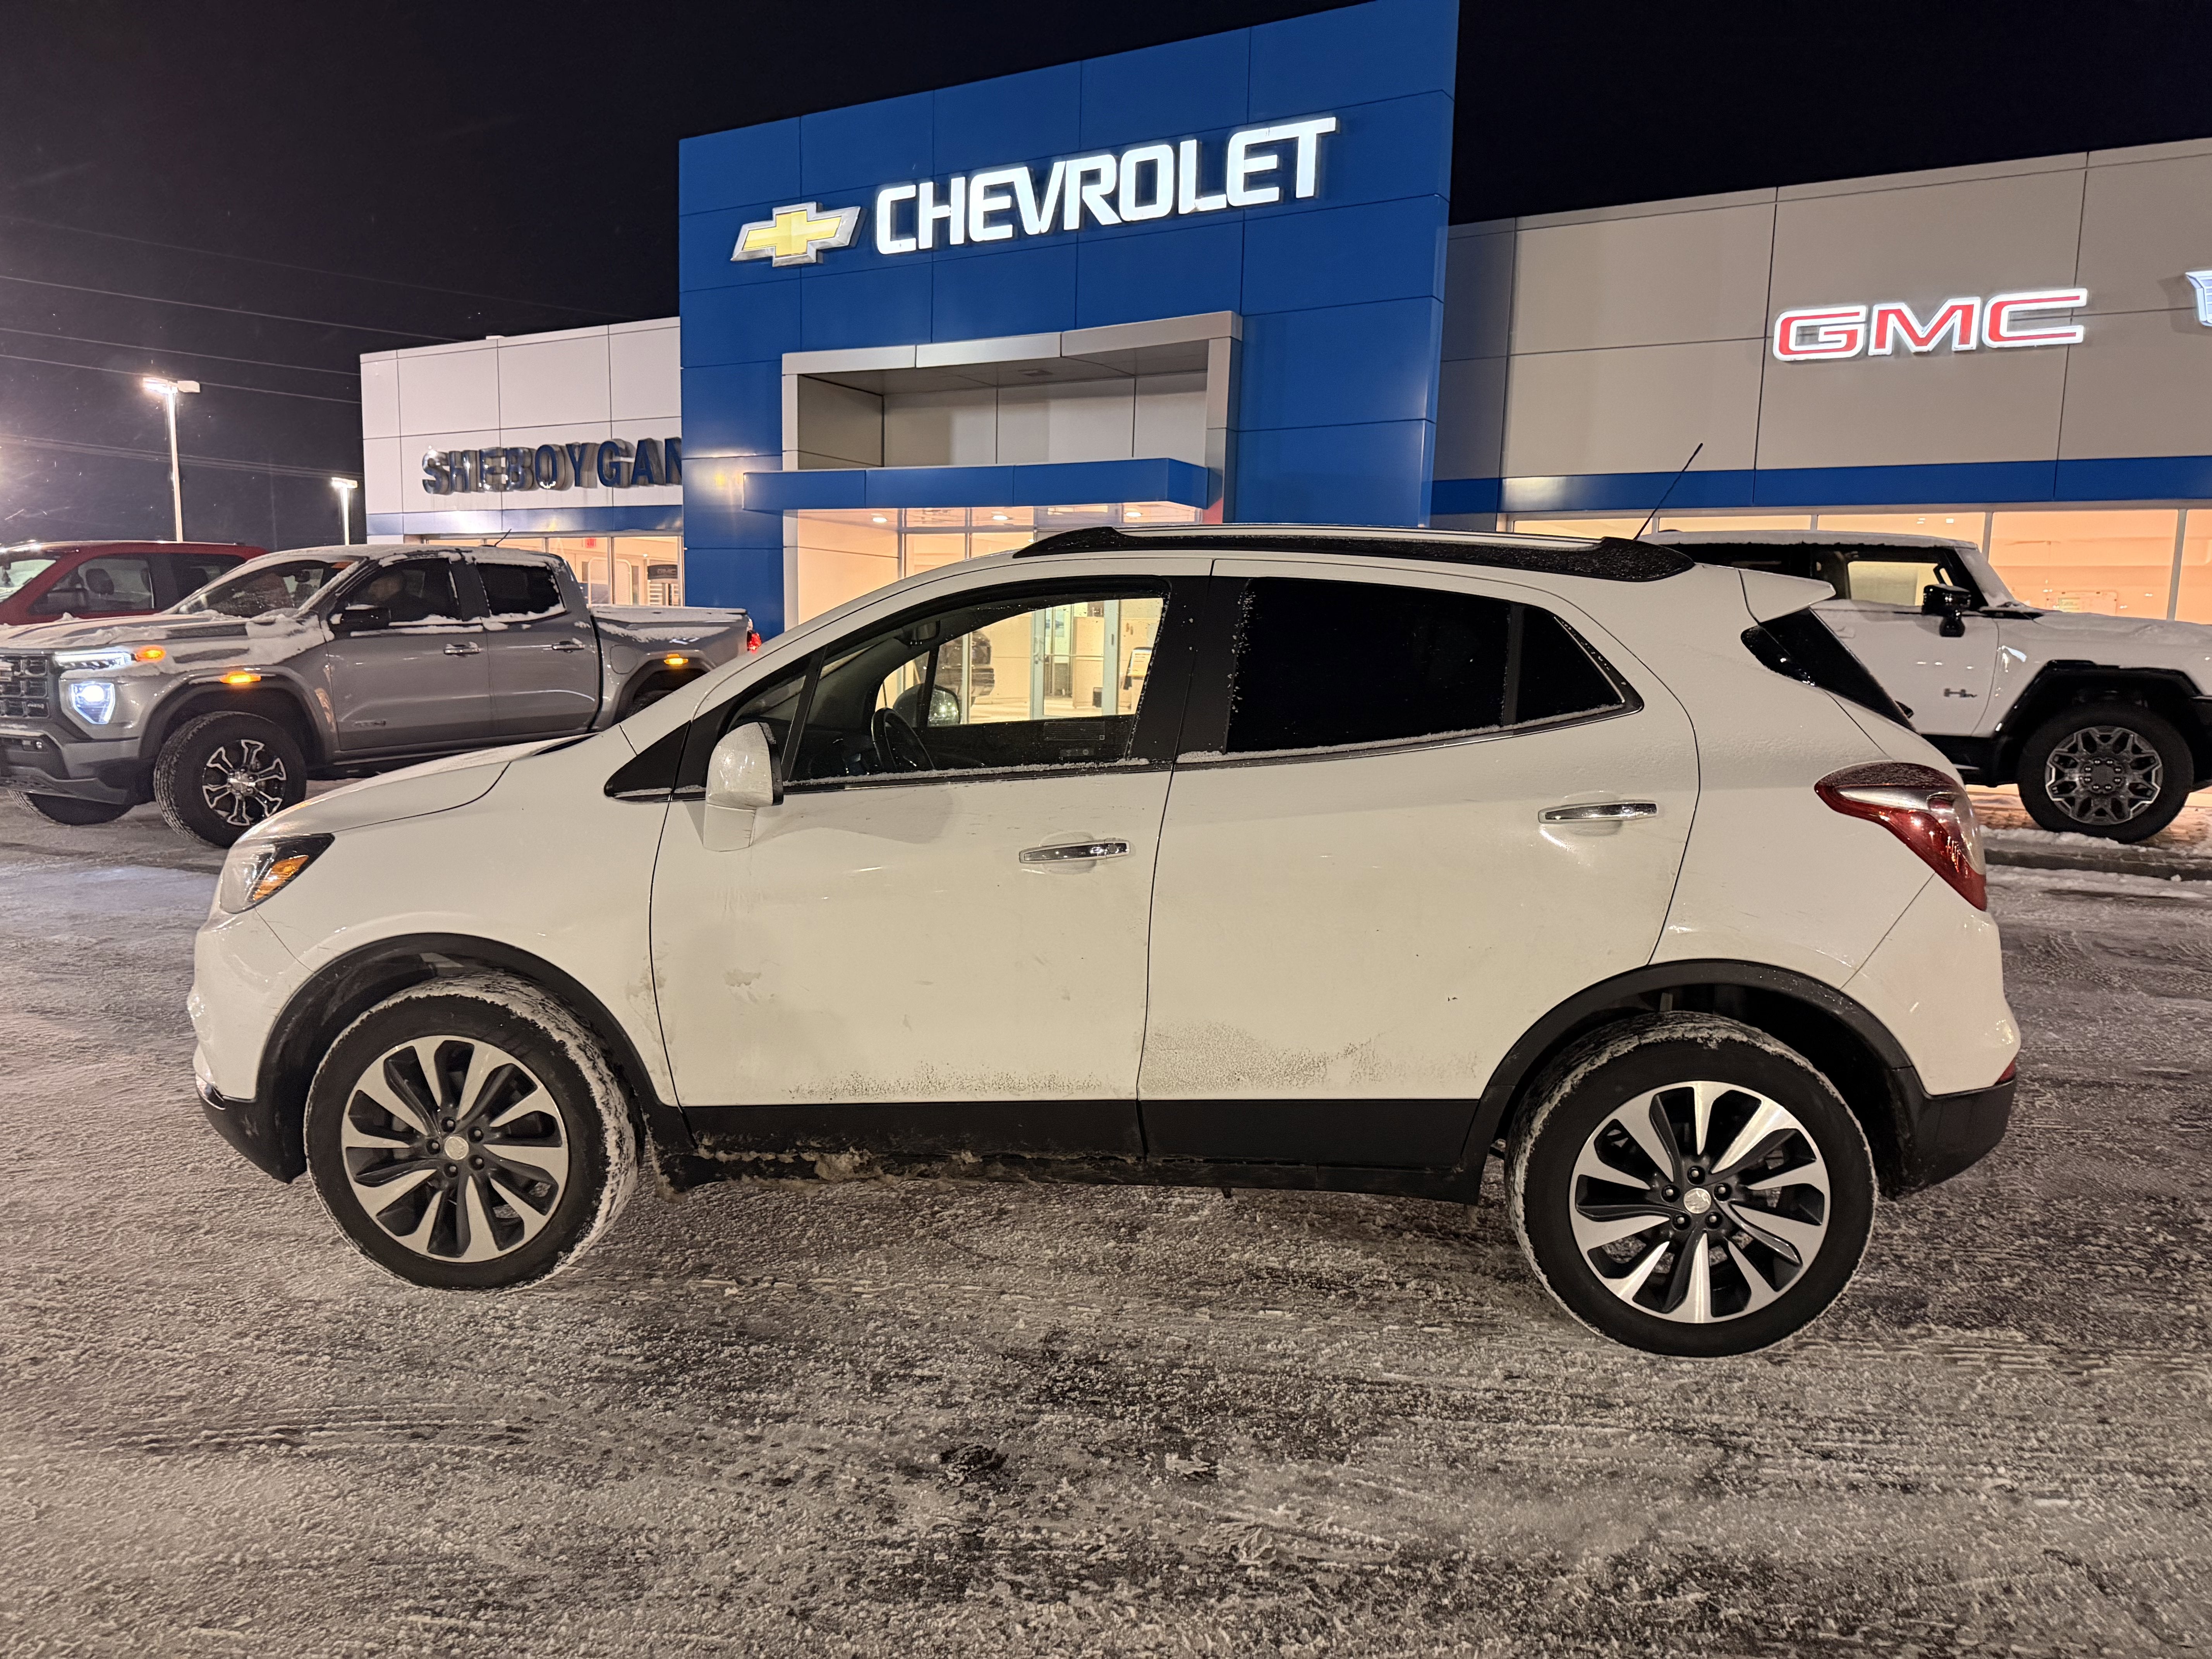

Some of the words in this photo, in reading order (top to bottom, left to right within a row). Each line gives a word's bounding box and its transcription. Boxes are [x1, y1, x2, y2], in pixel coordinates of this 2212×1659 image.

[876, 117, 1336, 254] CHEVROLET
[1772, 288, 2088, 361] GMC
[422, 437, 682, 495] SHEBOYGAN
